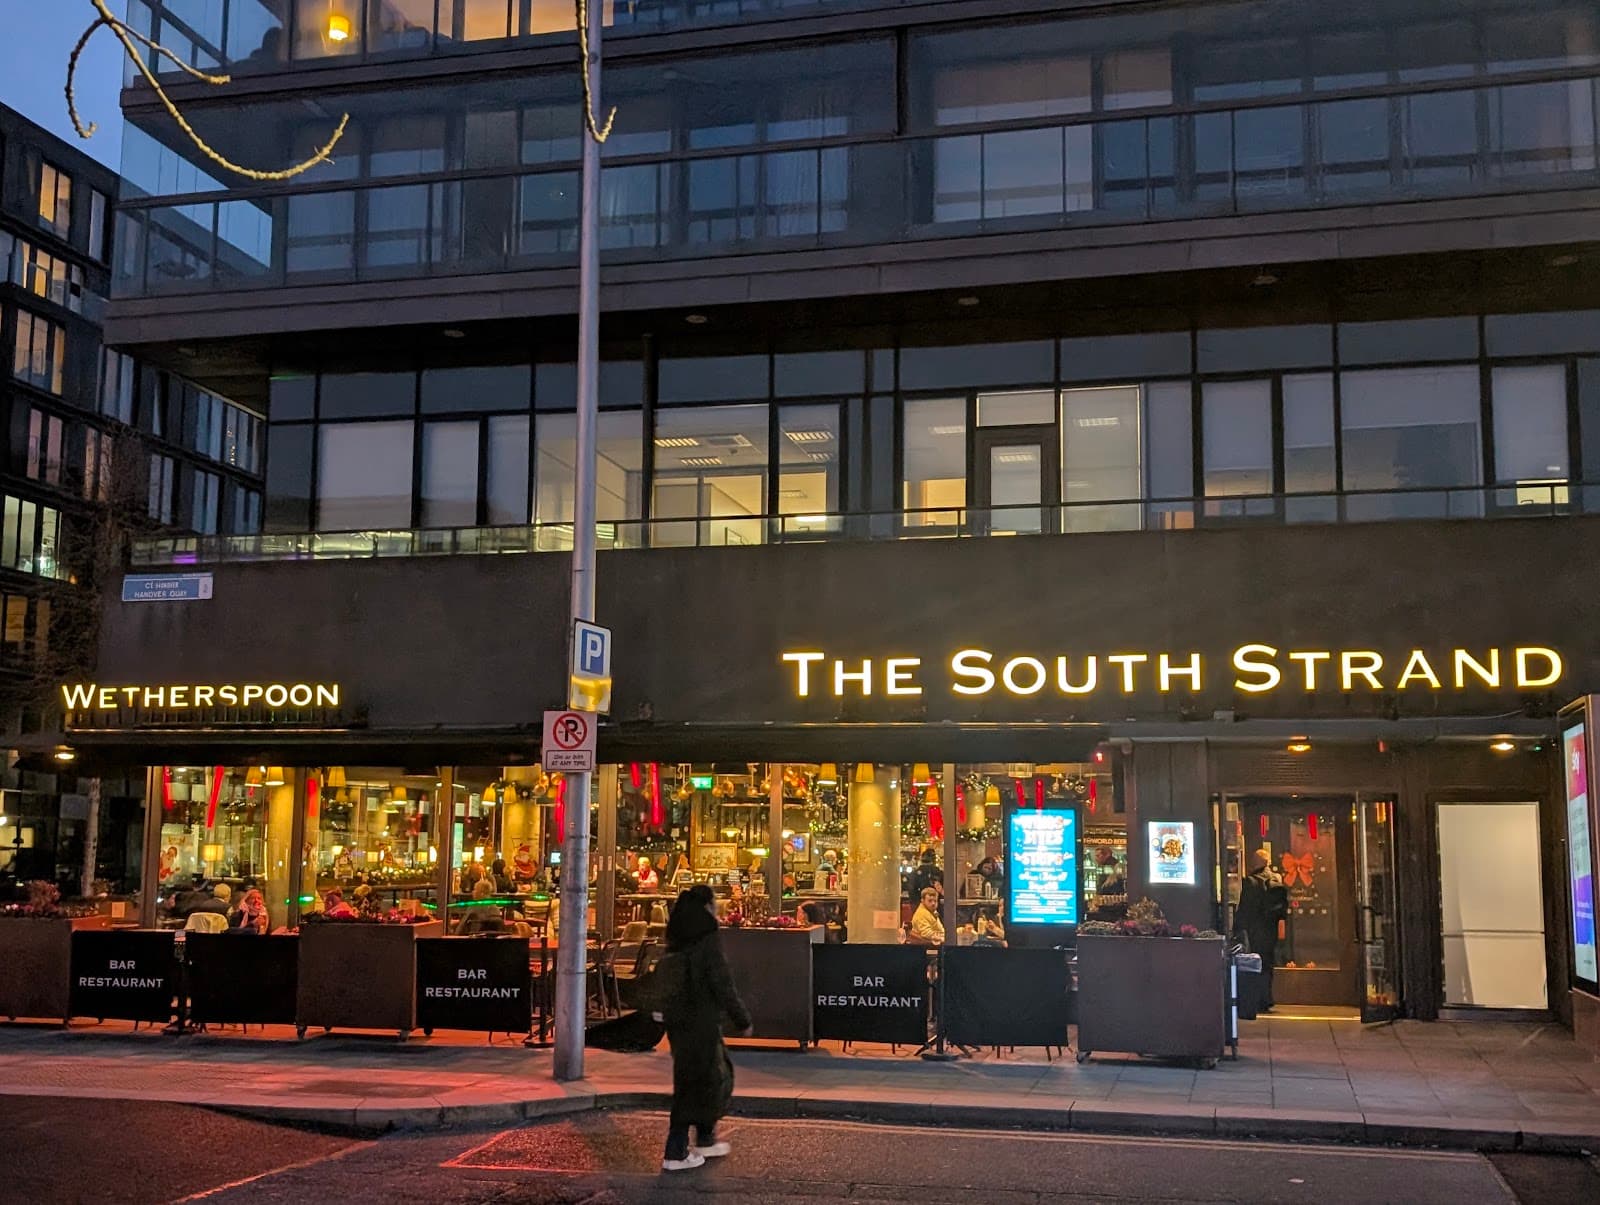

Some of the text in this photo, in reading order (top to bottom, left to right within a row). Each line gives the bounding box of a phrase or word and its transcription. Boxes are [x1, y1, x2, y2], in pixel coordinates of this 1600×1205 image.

[585, 632, 602, 670] P
[782, 644, 1563, 697] THE SOUTH STRAND
[62, 684, 340, 710] WETHERSPOON
[109, 960, 136, 969] BAR
[457, 969, 487, 979] BAR
[79, 977, 164, 988] RESTAURANT
[853, 976, 885, 987] BAR
[425, 987, 520, 998] RESTAURANT
[817, 995, 922, 1008] RESTAURANT
